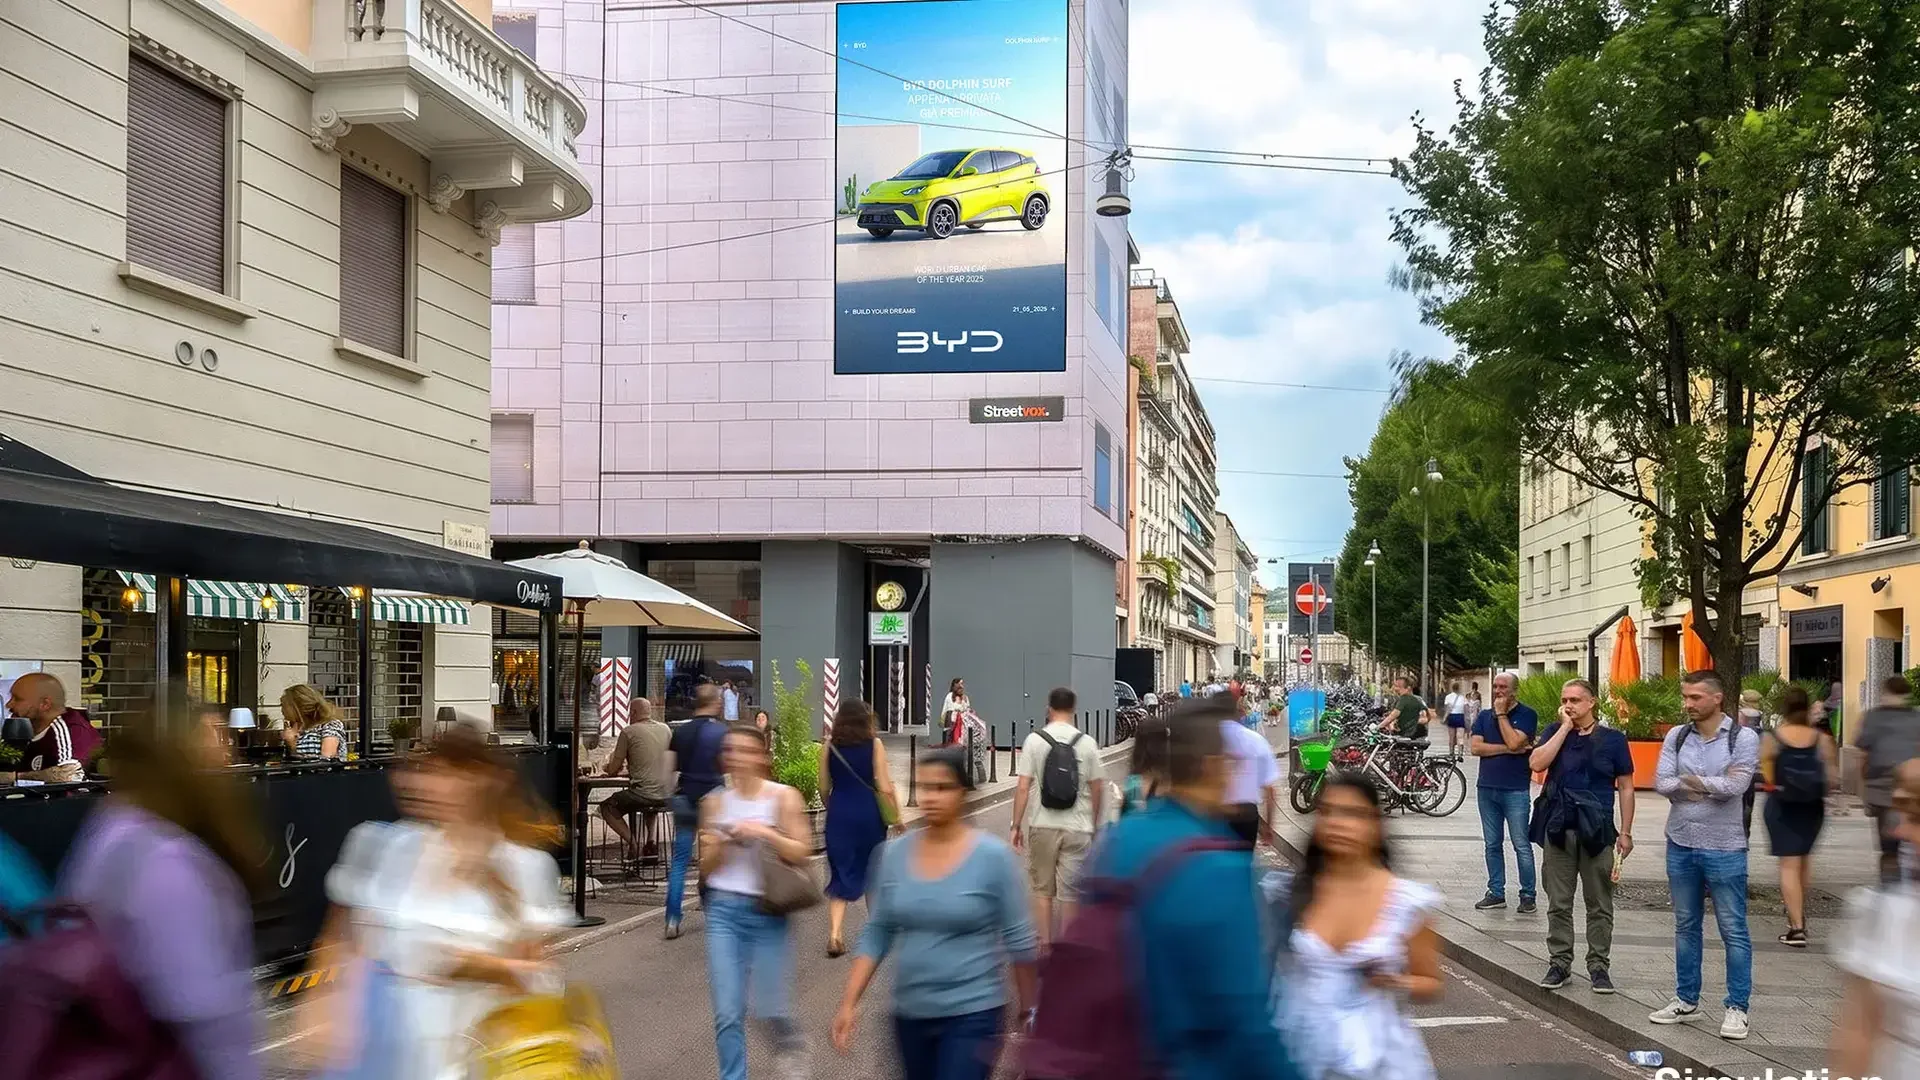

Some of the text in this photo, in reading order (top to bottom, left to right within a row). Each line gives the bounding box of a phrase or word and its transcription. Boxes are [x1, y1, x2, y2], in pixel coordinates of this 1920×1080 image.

[903, 77, 1013, 91] BYD DOLPHIN SURF
[908, 93, 950, 105] APPENA
[943, 265, 970, 273] URBAN
[971, 264, 987, 273] CAR
[916, 274, 984, 284] OF THE YEAR 2025
[897, 330, 1004, 353] BYD
